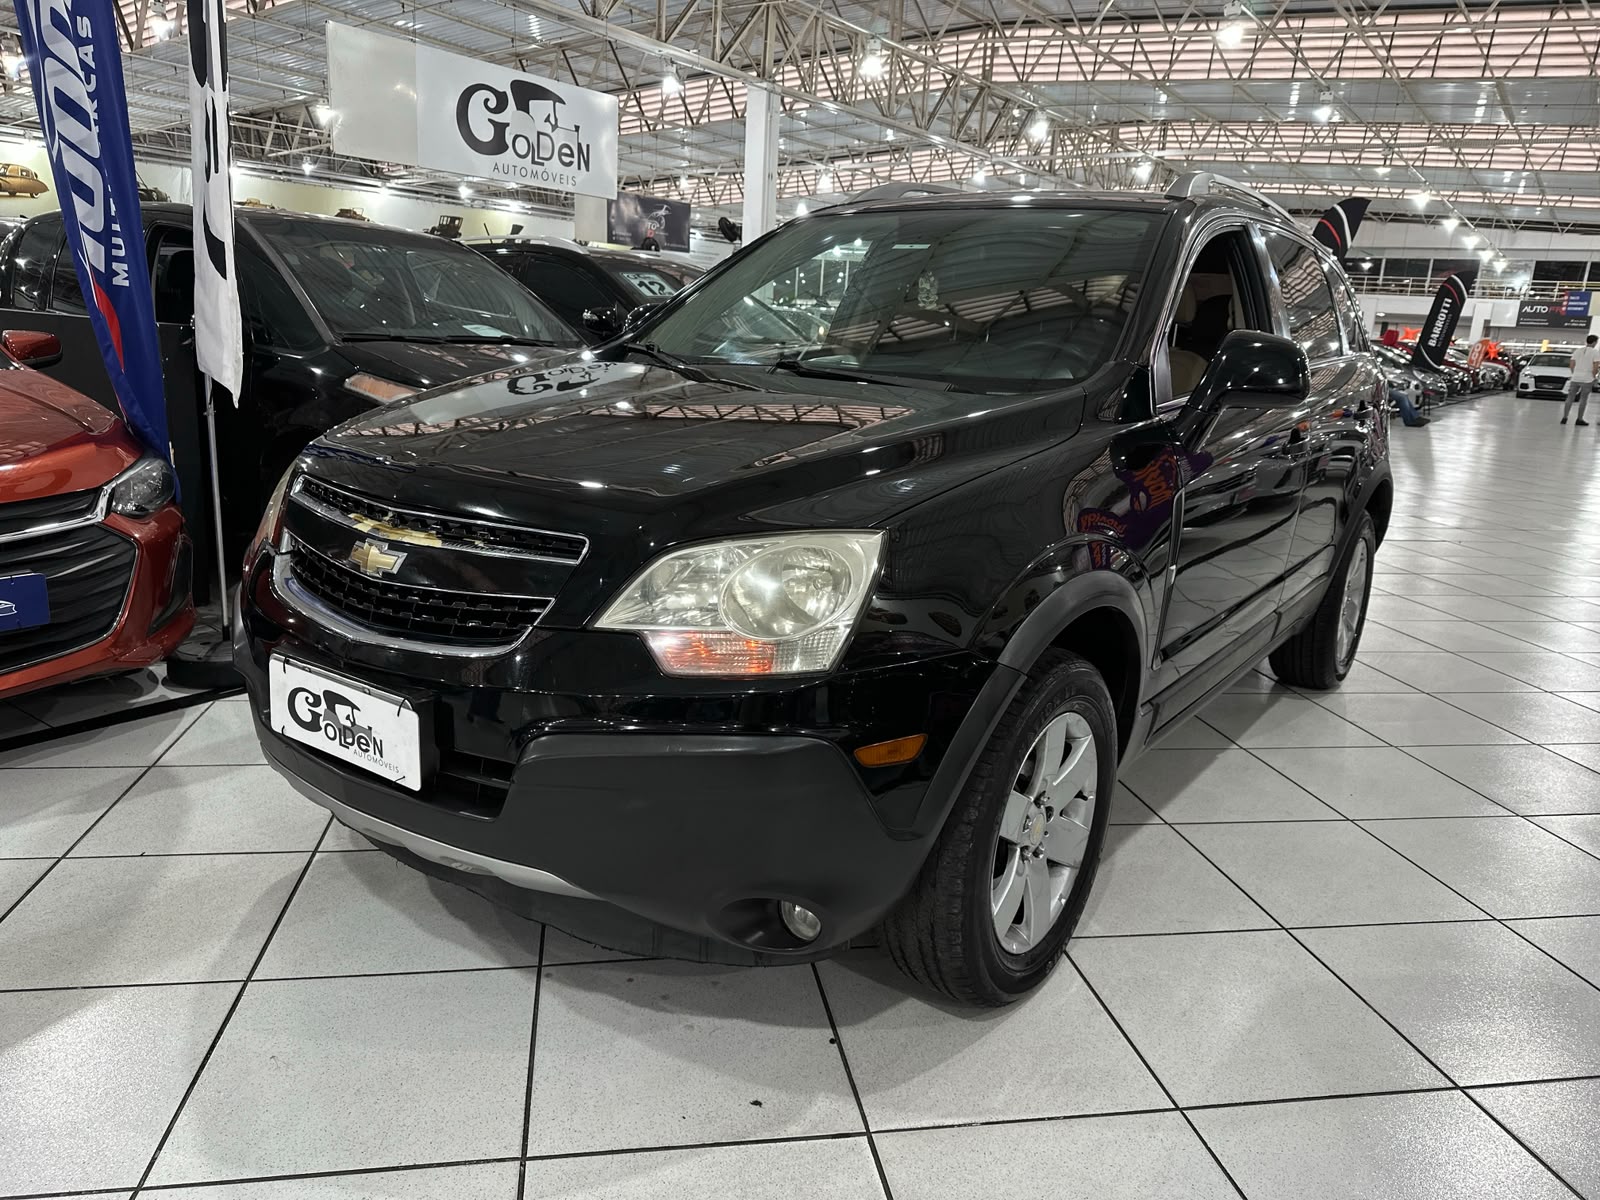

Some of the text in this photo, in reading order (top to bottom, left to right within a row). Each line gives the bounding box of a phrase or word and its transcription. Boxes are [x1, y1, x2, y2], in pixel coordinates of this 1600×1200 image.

[492, 161, 578, 187] AUTOMÓVEIS
[1521, 305, 1549, 313] AUTO
[1427, 297, 1453, 348] BARROTTI
